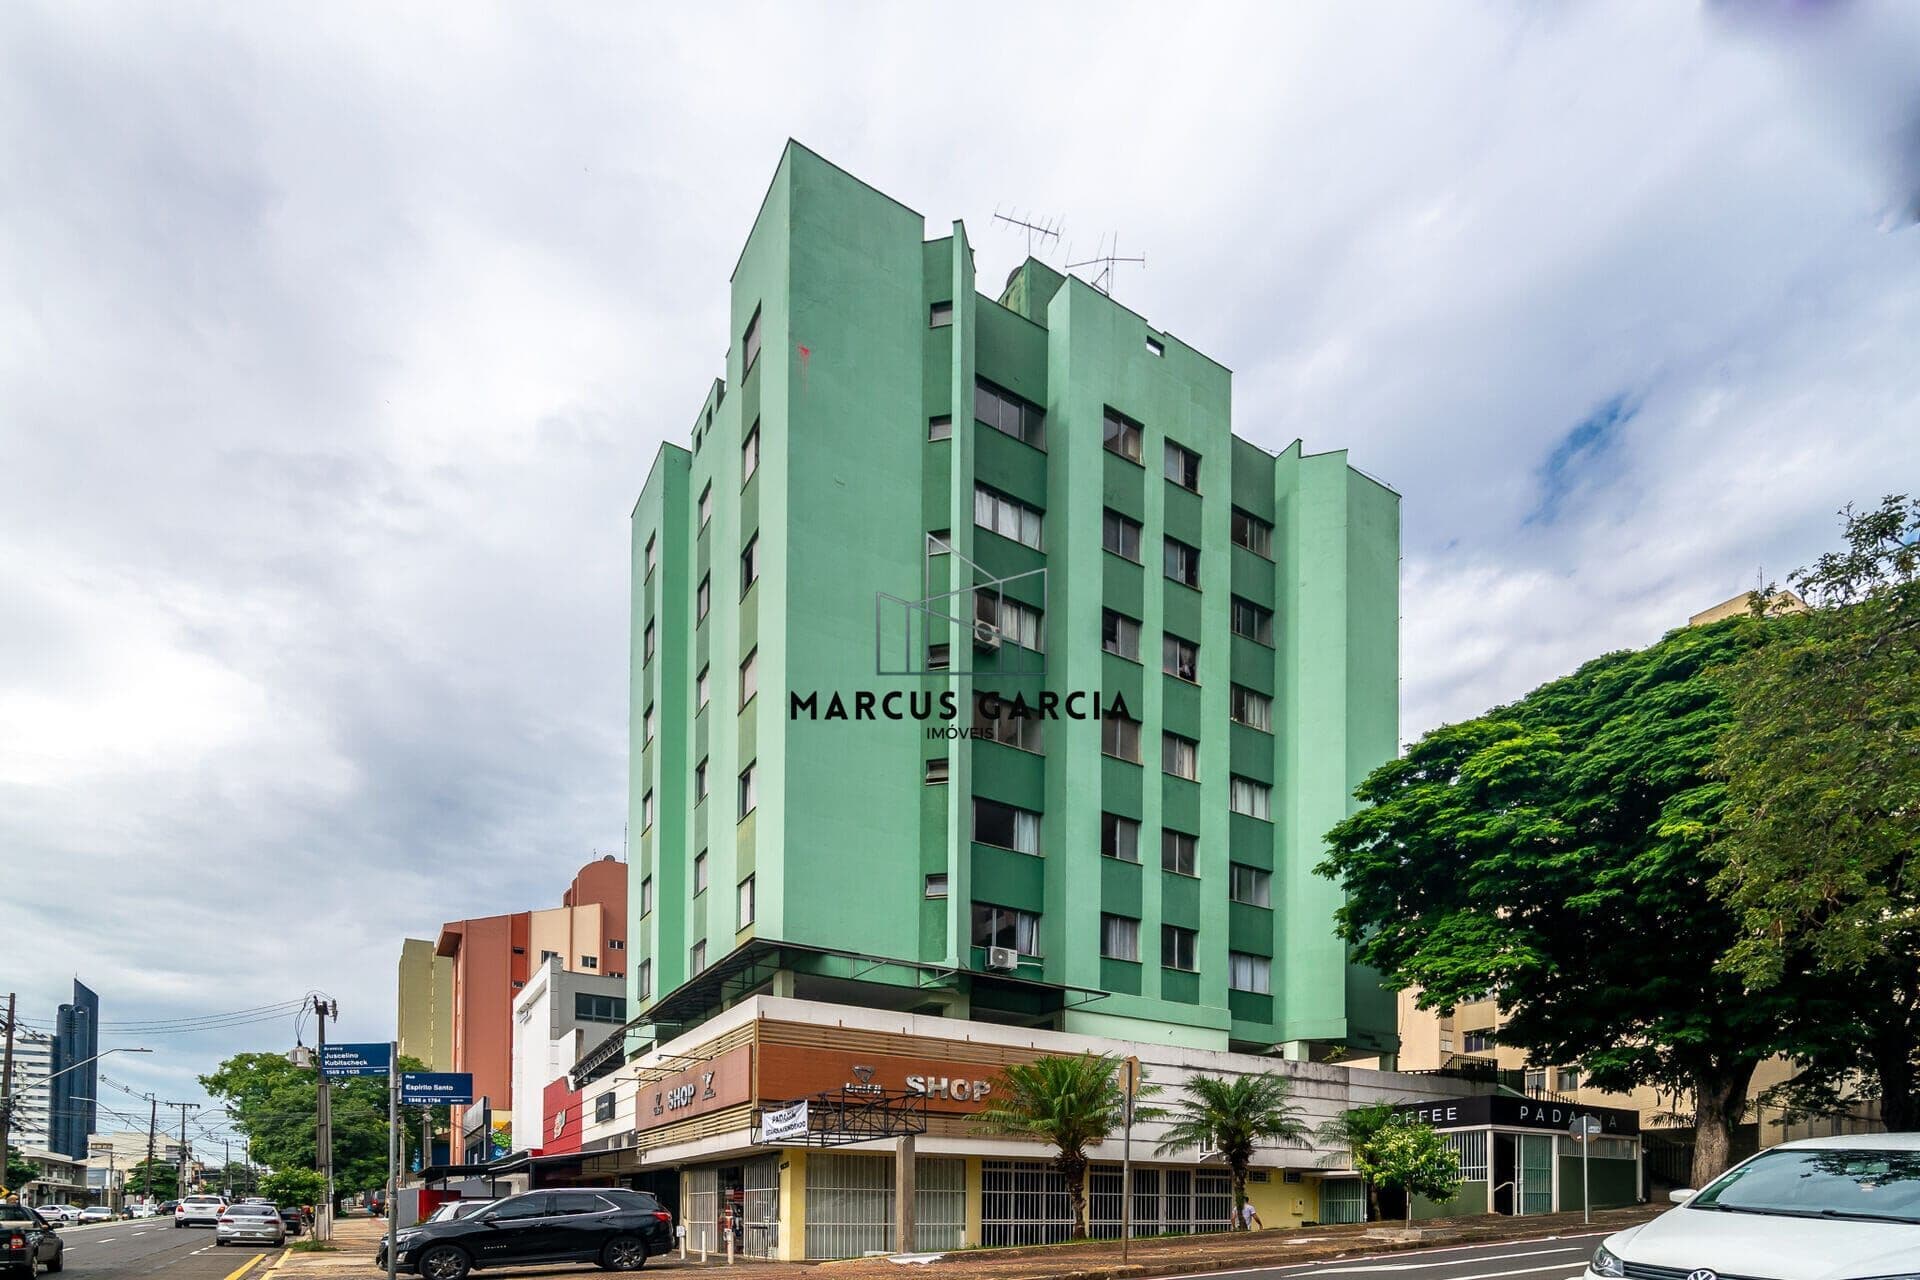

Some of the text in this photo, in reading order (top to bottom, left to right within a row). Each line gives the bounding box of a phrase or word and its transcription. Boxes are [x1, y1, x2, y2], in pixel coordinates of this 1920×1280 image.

[667, 1083, 696, 1111] SHOP
[905, 1074, 992, 1102] SHOP
[1519, 1105, 1617, 1128] PADAIA
